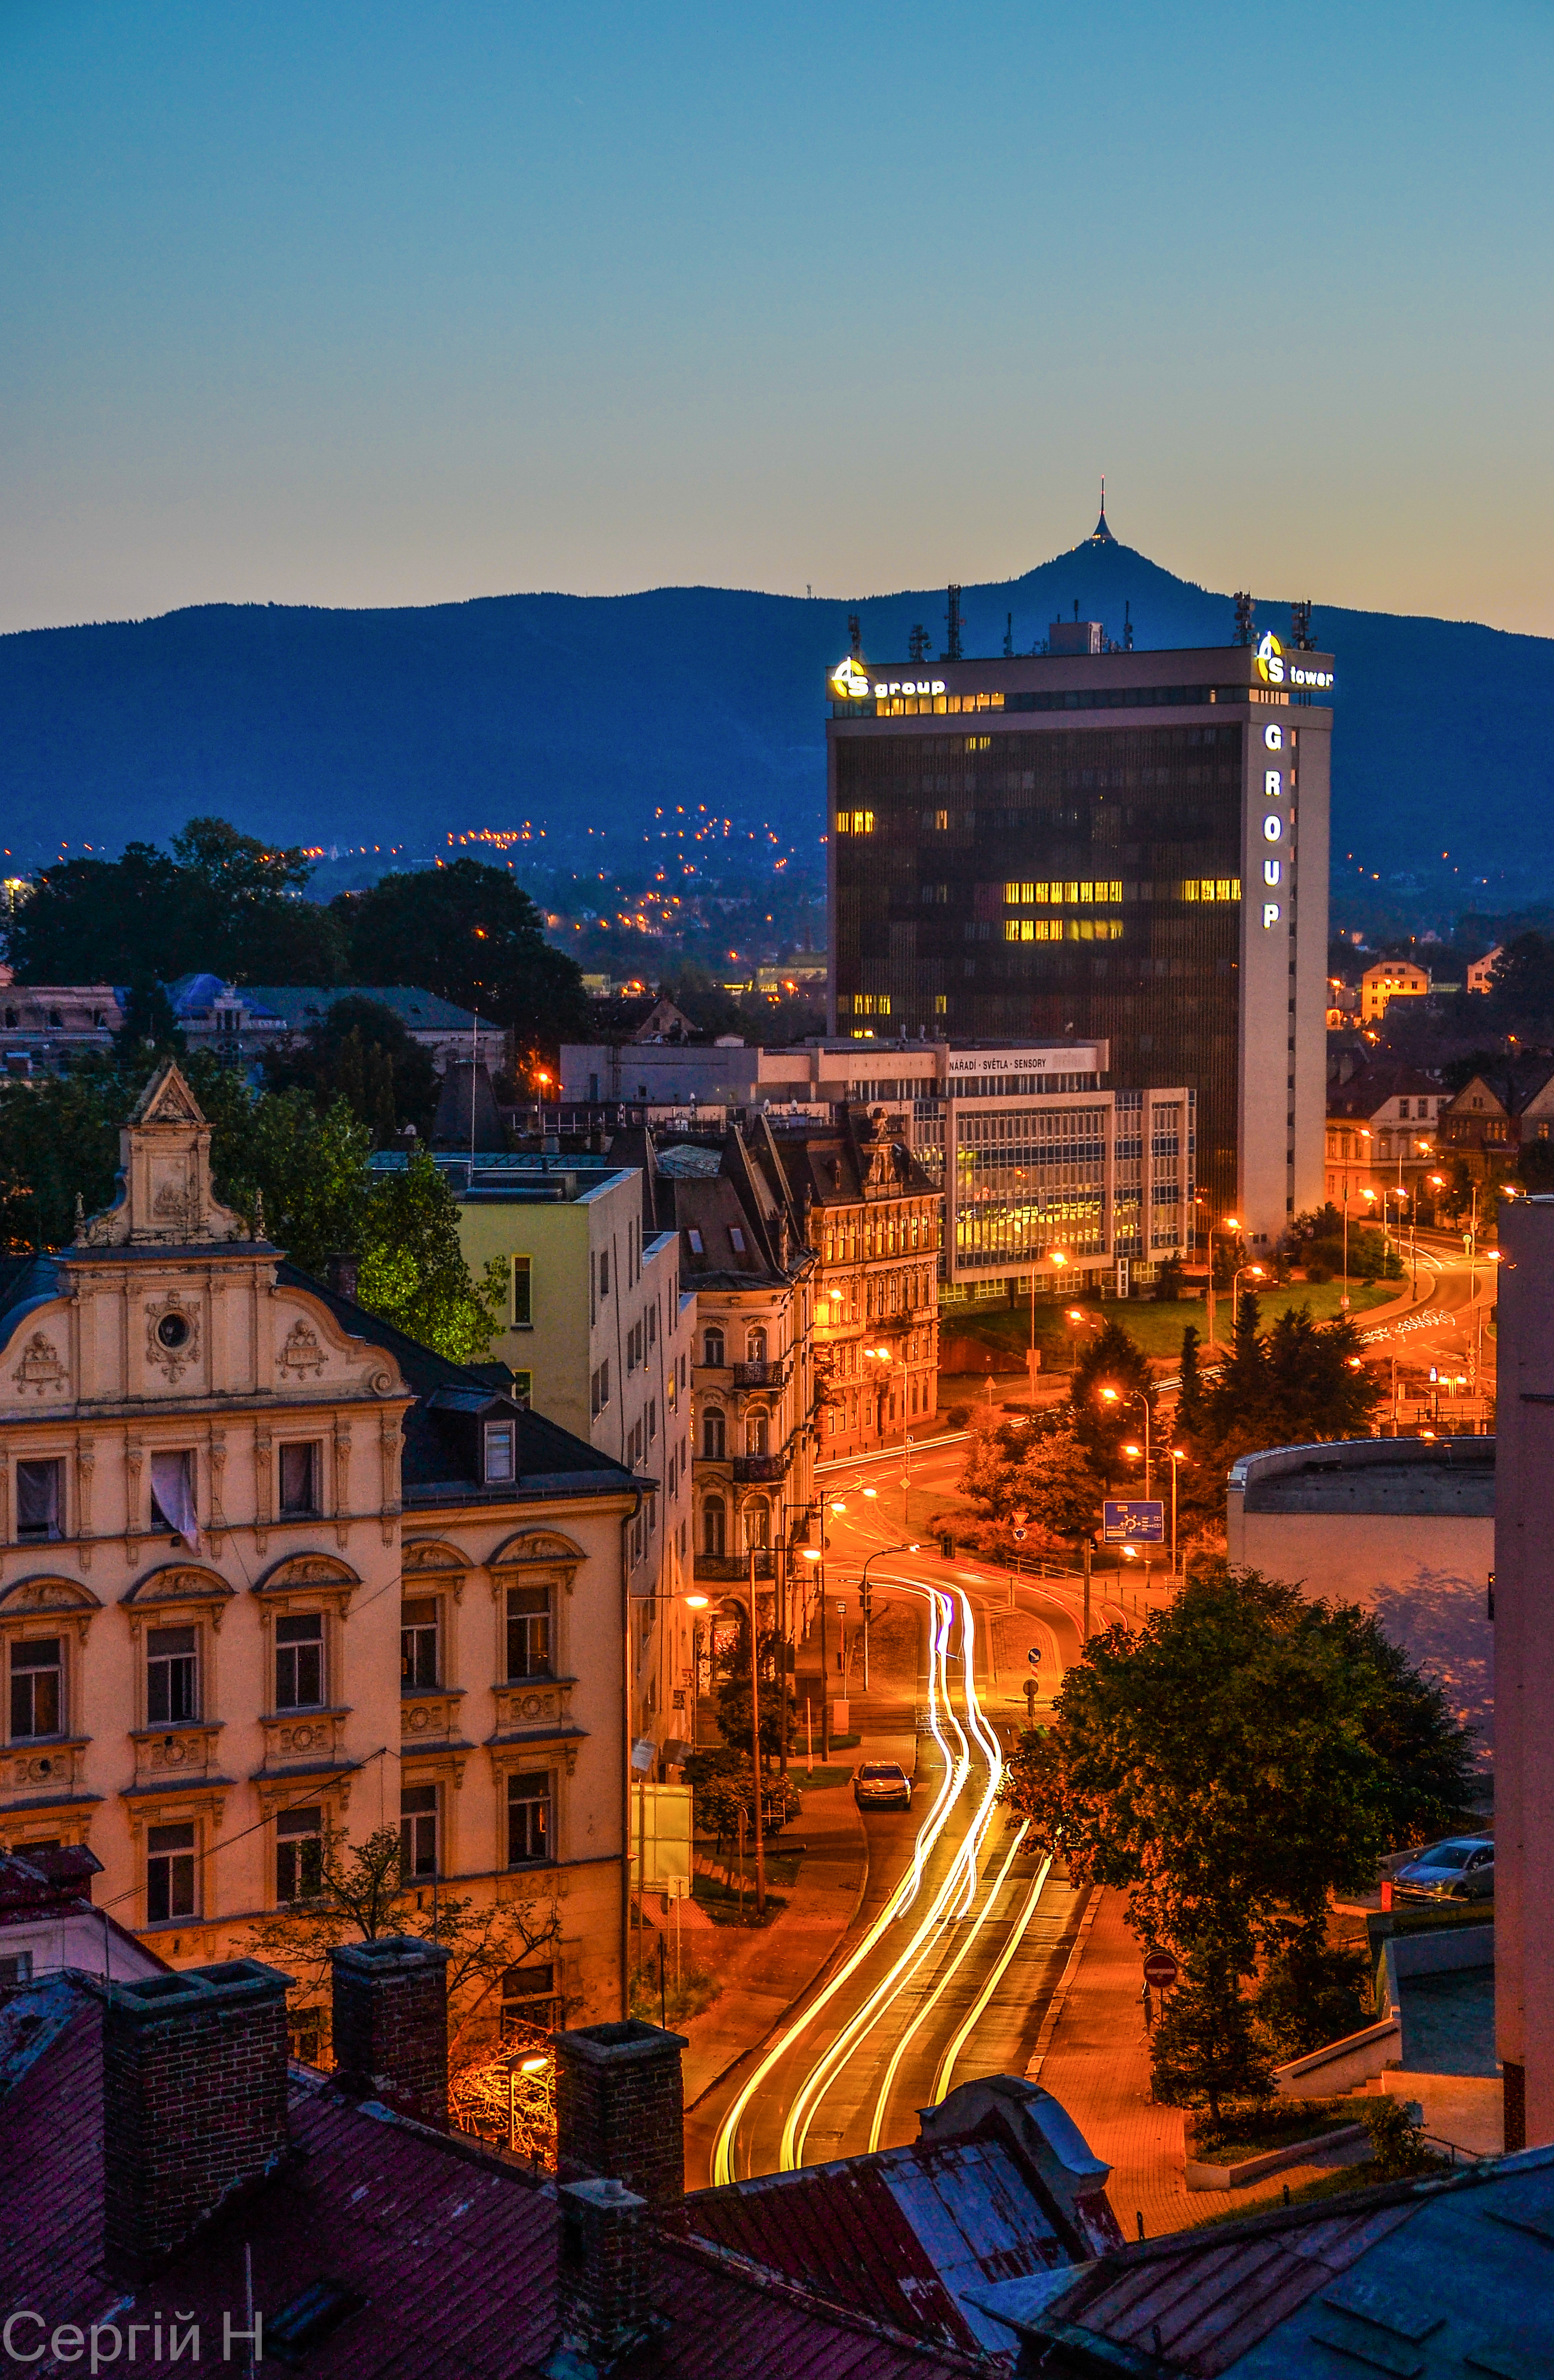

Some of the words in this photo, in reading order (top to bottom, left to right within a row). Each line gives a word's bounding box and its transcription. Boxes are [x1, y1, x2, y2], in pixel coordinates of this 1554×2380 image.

[1290, 665, 1334, 687] tower
[874, 680, 946, 698] group
[1263, 723, 1282, 929] GROUP
[949, 1059, 977, 1071] NÁŘADÍ
[983, 1057, 1009, 1070] SVĚTLA
[1014, 1058, 1047, 1069] SENSORY
